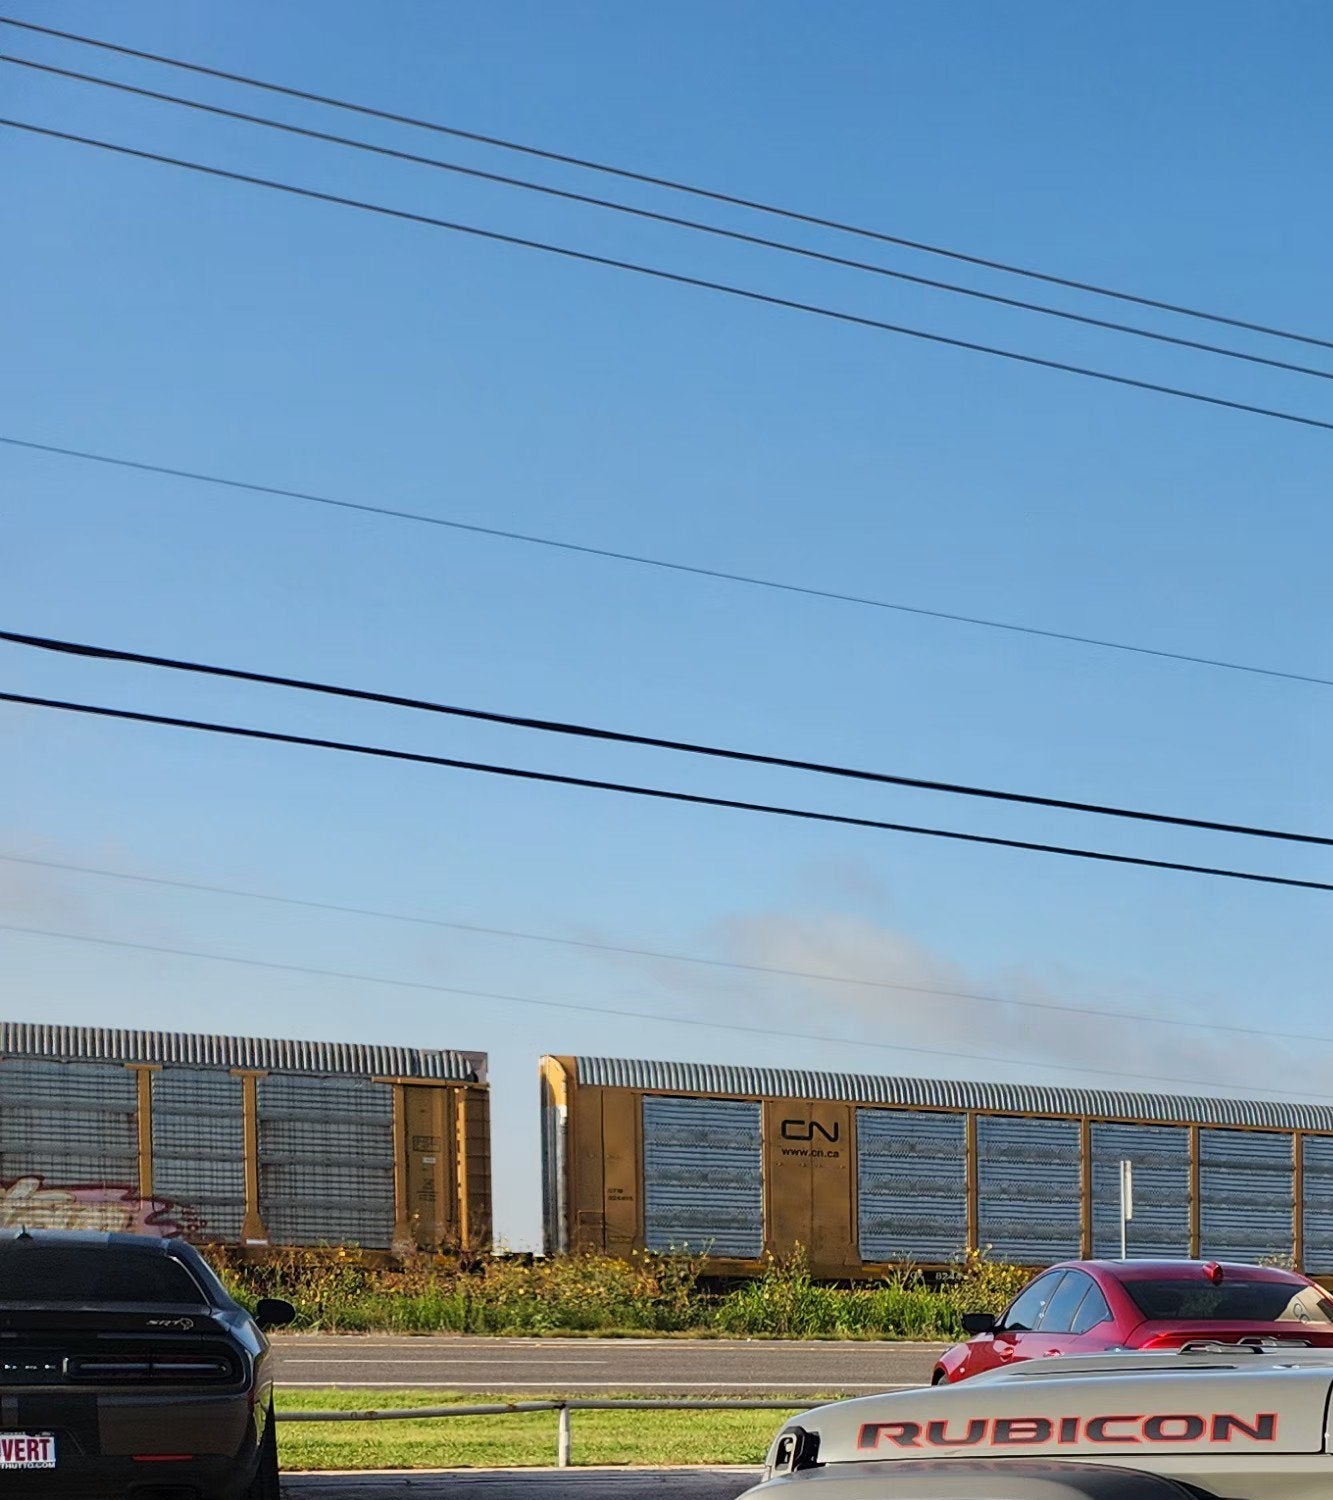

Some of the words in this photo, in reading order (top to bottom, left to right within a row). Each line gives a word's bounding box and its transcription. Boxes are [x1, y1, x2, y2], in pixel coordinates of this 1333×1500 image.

[781, 1119, 840, 1143] CN
[781, 1148, 840, 1158] www.cn.ca
[857, 1412, 1279, 1451] RUBICON
[0, 1438, 51, 1461] VERT
